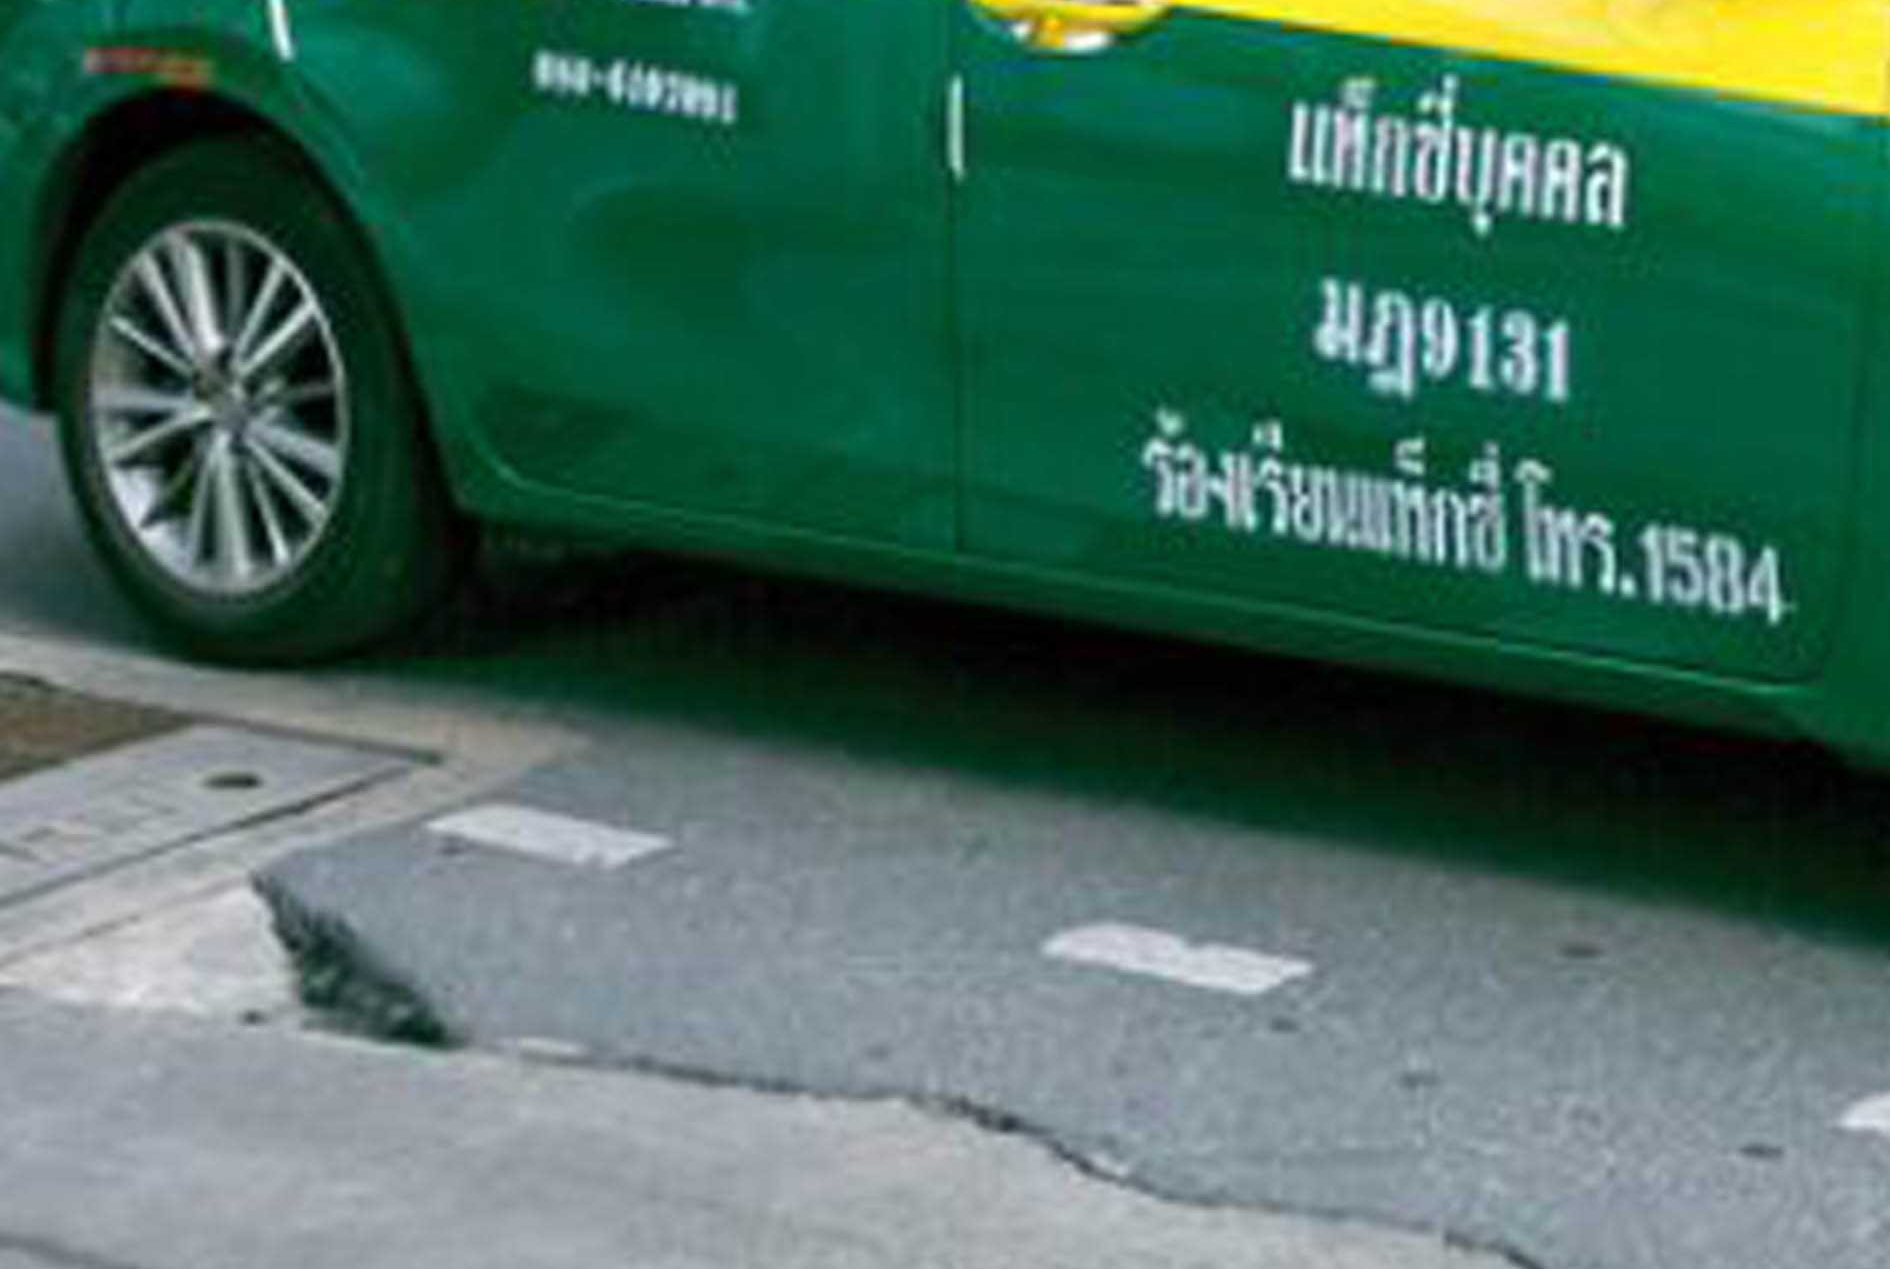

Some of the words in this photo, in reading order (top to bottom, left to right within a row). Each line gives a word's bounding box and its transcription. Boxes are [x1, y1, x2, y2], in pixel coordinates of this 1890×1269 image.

[1289, 74, 1628, 233] แท็กซี่บุคคล
[1141, 409, 1507, 571] ร้องเรียนแท็กซี่
[1514, 458, 1797, 626] โทร.1584
